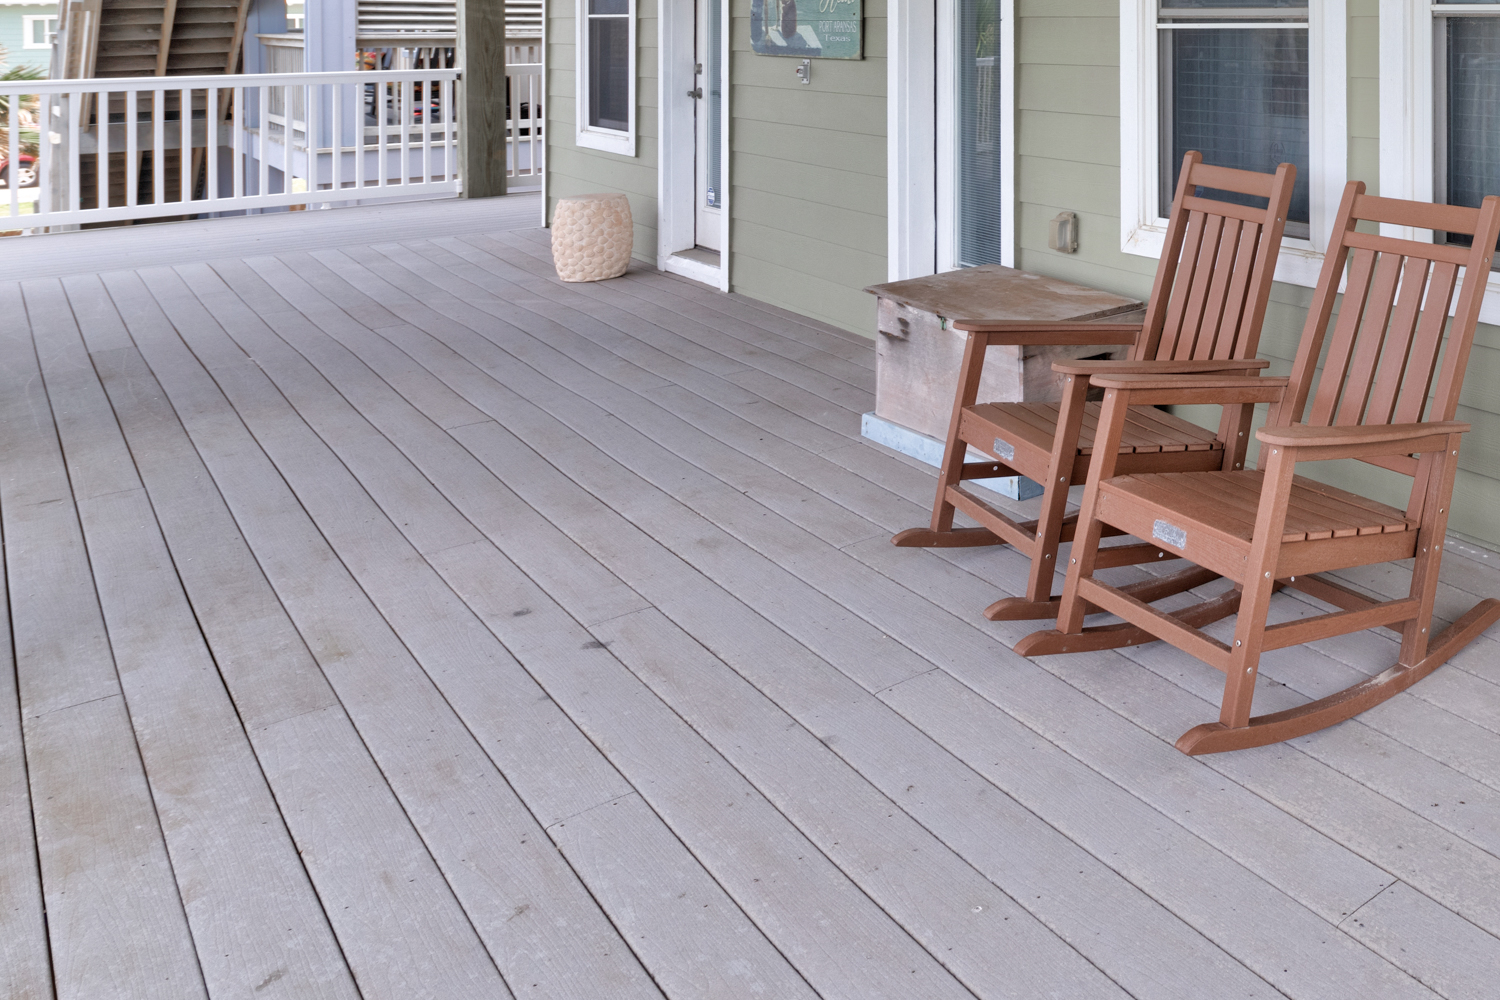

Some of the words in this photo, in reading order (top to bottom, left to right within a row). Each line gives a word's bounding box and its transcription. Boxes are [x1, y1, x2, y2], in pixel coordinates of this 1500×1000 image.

[819, 20, 833, 33] PORT
[833, 20, 857, 33] ARANSAS
[823, 33, 851, 42] Texas
